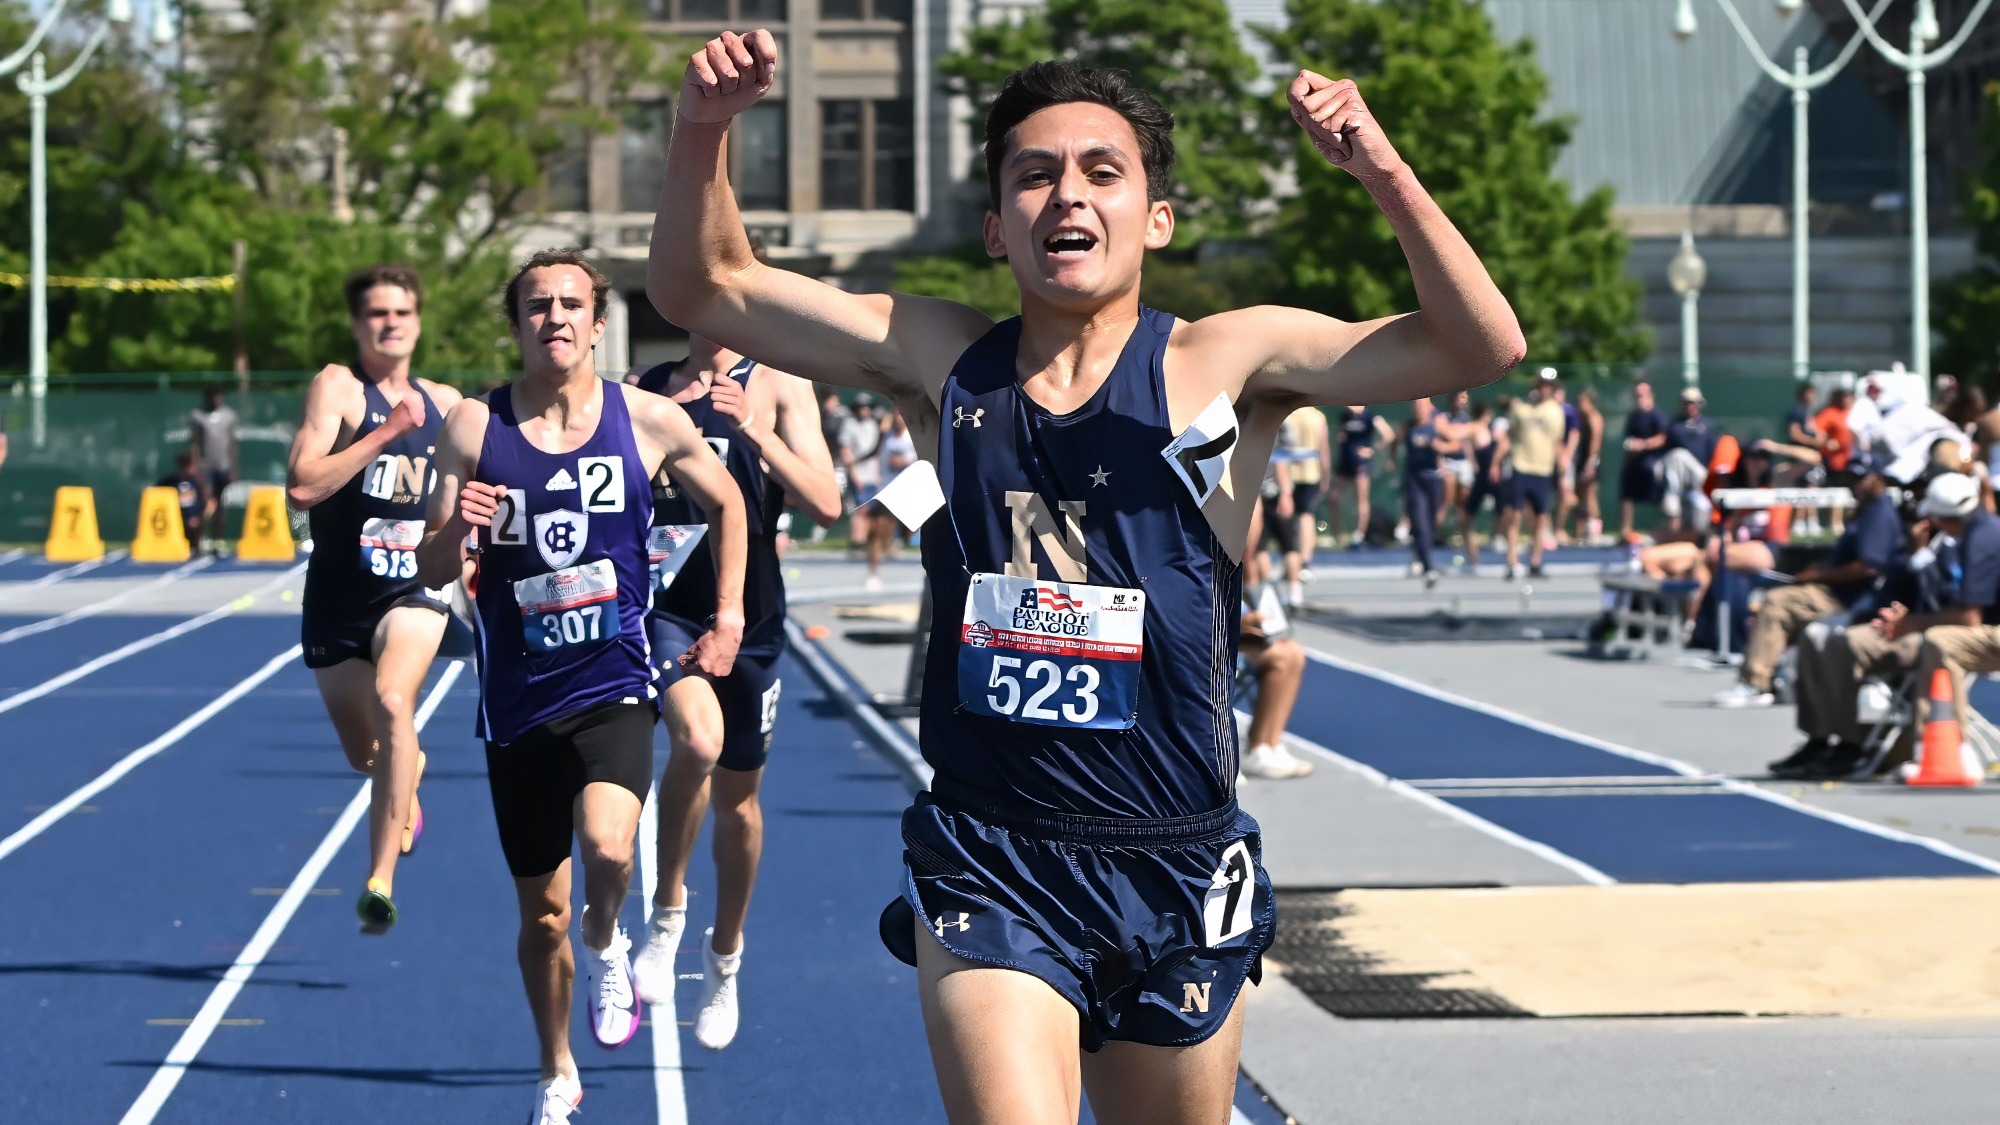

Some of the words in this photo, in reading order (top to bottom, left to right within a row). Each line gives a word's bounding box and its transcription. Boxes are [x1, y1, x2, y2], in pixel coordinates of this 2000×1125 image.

[395, 454, 428, 495] N
[586, 462, 616, 506] 2
[66, 507, 81, 536] 7
[152, 507, 168, 536] 6
[255, 506, 273, 536] 5
[496, 494, 520, 541] 2
[1004, 491, 1087, 582] N
[371, 548, 418, 579] 513
[542, 606, 602, 647] 307
[1013, 606, 1089, 626] PATRIOT
[986, 654, 1100, 724] 523
[1180, 982, 1212, 1013] N
